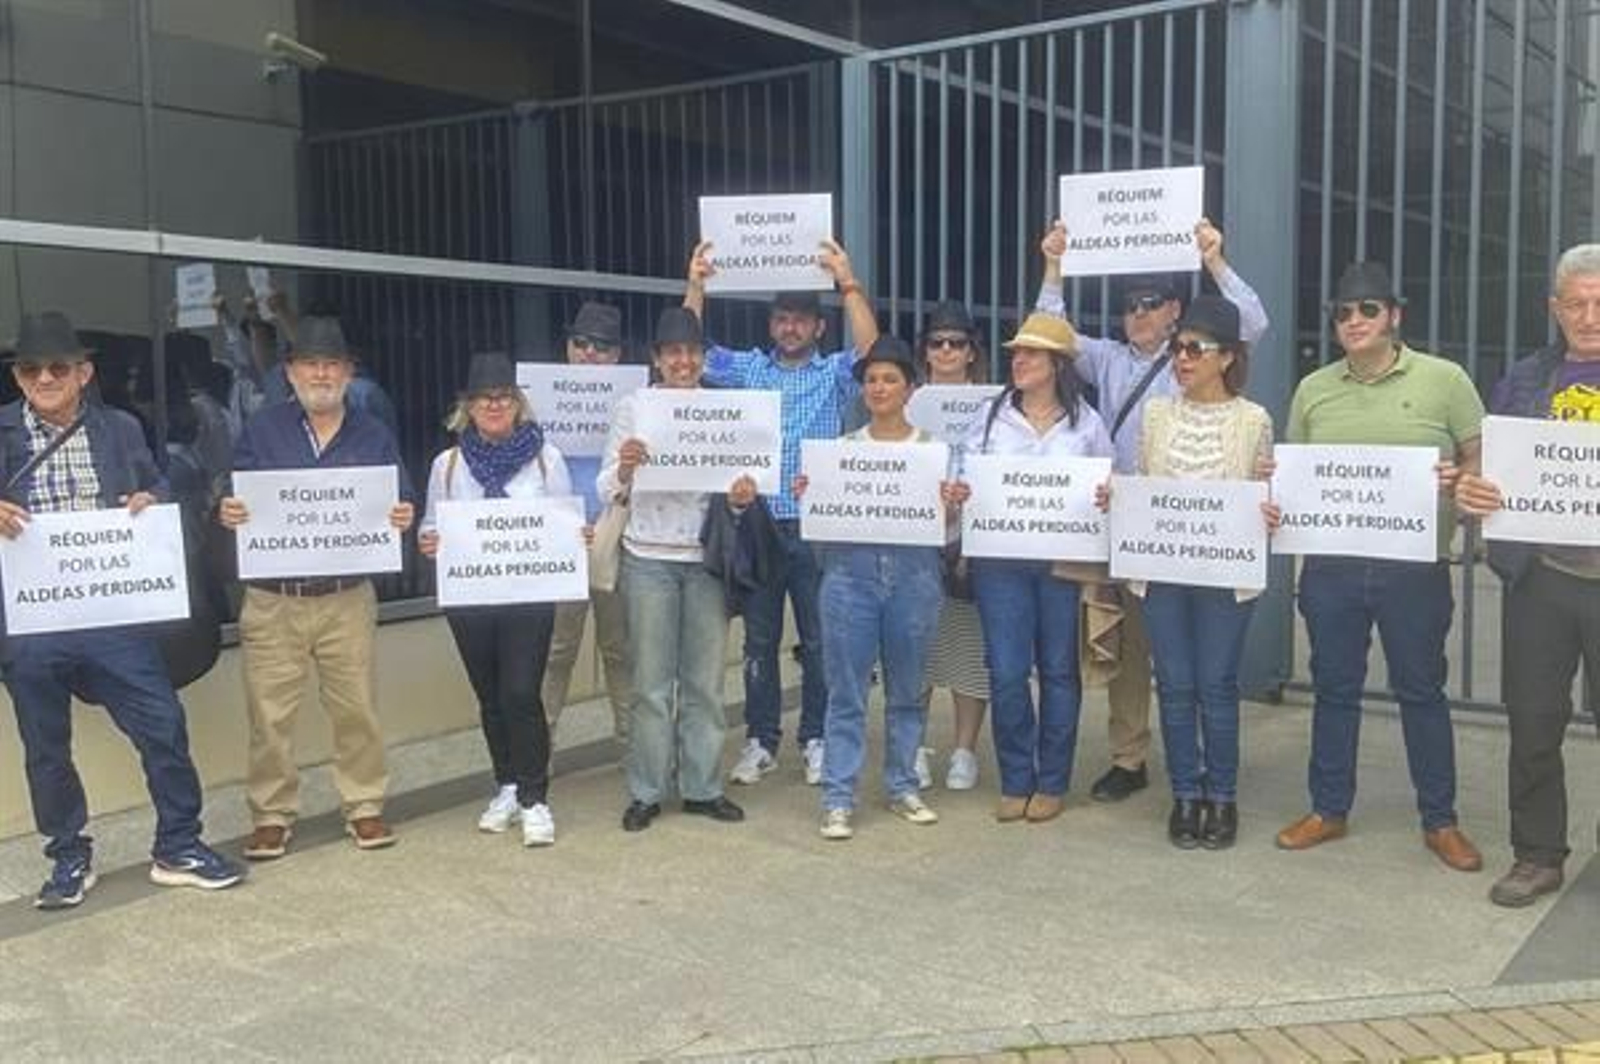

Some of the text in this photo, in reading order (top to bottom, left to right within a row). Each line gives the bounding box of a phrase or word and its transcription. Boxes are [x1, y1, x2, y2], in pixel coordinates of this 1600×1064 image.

[1103, 211, 1158, 226] POR LAS
[742, 234, 792, 246] POR LAS
[1071, 232, 1192, 250] ALDEAS PERDIDAS
[711, 255, 760, 269] ALDEAS
[556, 401, 608, 413] POR LAS
[673, 405, 742, 422] RÉQUIEM
[942, 401, 980, 414] RÉQU
[577, 422, 610, 434] PERD
[679, 432, 737, 445] POR LAS
[641, 454, 771, 468] ALDEAS PERDIDAS
[840, 457, 907, 472] RÉQUIEM
[1315, 461, 1391, 479] RÉQUIEM
[1002, 472, 1071, 488] RÉQUIEM
[1540, 472, 1580, 488] POR
[279, 487, 355, 502] RÉQUIEM
[844, 482, 901, 496] POR LAS
[1321, 489, 1385, 504] POR LAS
[809, 503, 936, 520] ALDEAS PERDIDAS
[1007, 497, 1065, 510] POR LAS
[1151, 495, 1224, 512] RÉQUIEM
[287, 511, 351, 526] POR LAS
[476, 516, 544, 532] RÉQUIEM
[971, 518, 1100, 535] ALDEAS PERDIDAS
[1281, 513, 1426, 533] ALDEAS PERDIDAS
[1155, 519, 1216, 536] POR LAS
[50, 528, 133, 549] RÉQUIEM
[249, 531, 391, 550] ALDEAS PERDIDAS
[482, 539, 541, 554] POR LAS
[1119, 540, 1256, 562] ALDEAS PERDIDAS
[59, 553, 131, 574] POR LAS
[447, 560, 576, 579] ALDEAS PERDIDAS
[17, 574, 175, 604] ALDEAS PERDIDAS
